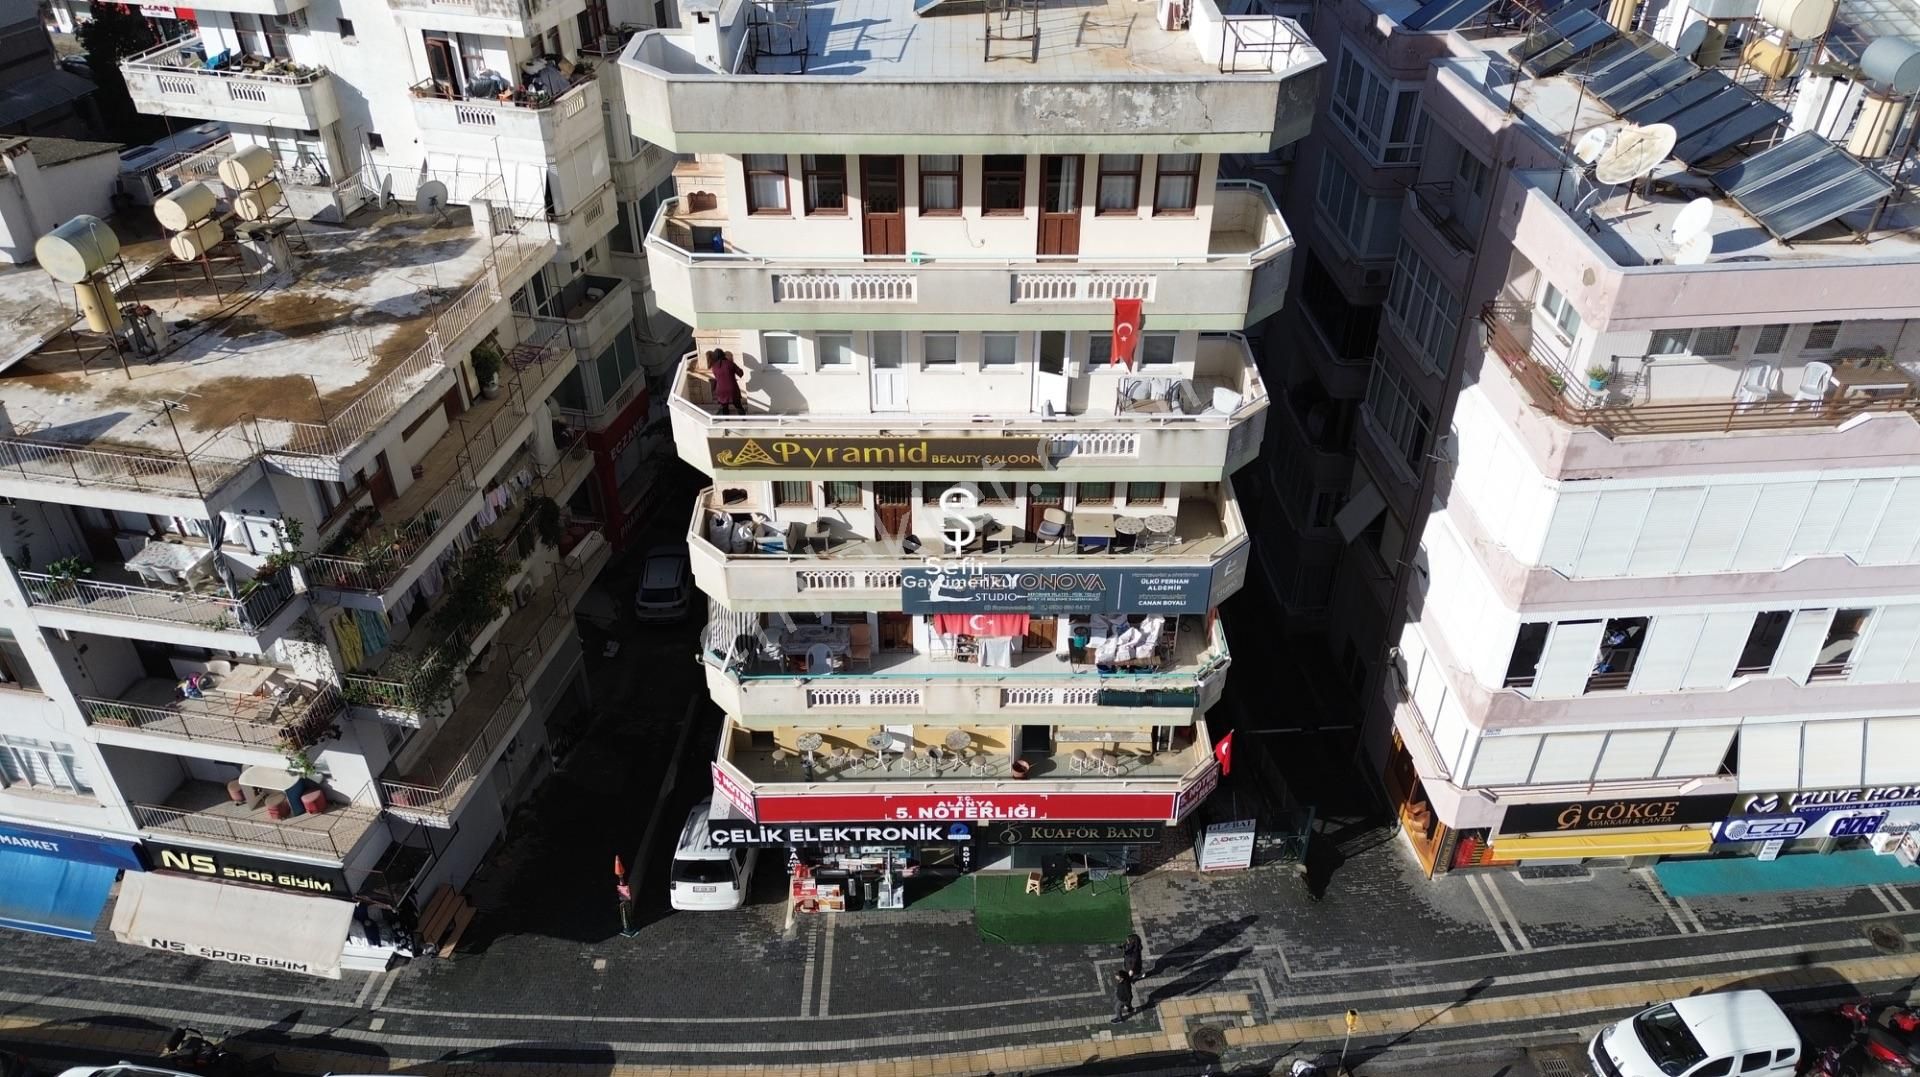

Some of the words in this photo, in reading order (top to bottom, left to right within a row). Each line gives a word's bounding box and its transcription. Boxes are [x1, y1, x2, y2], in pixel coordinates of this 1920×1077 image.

[772, 442, 927, 468] Pyramid
[931, 454, 981, 464] BEAUTY
[985, 454, 1041, 464] SALOON
[975, 592, 1017, 601] STUDIO
[1788, 789, 1862, 805] MUVE
[896, 807, 912, 819] 5.
[1587, 818, 1631, 827] AYAKKABI
[711, 825, 784, 845] ÇELİK
[789, 823, 943, 842] ELEKTRONİK
[1031, 824, 1099, 839] KUAFÖR
[1106, 826, 1155, 838] BANU
[0, 834, 59, 852] MARKET
[161, 850, 217, 874] NS
[223, 867, 274, 883] SPOR
[278, 875, 331, 892] GİYİM
[151, 938, 186, 951] NS
